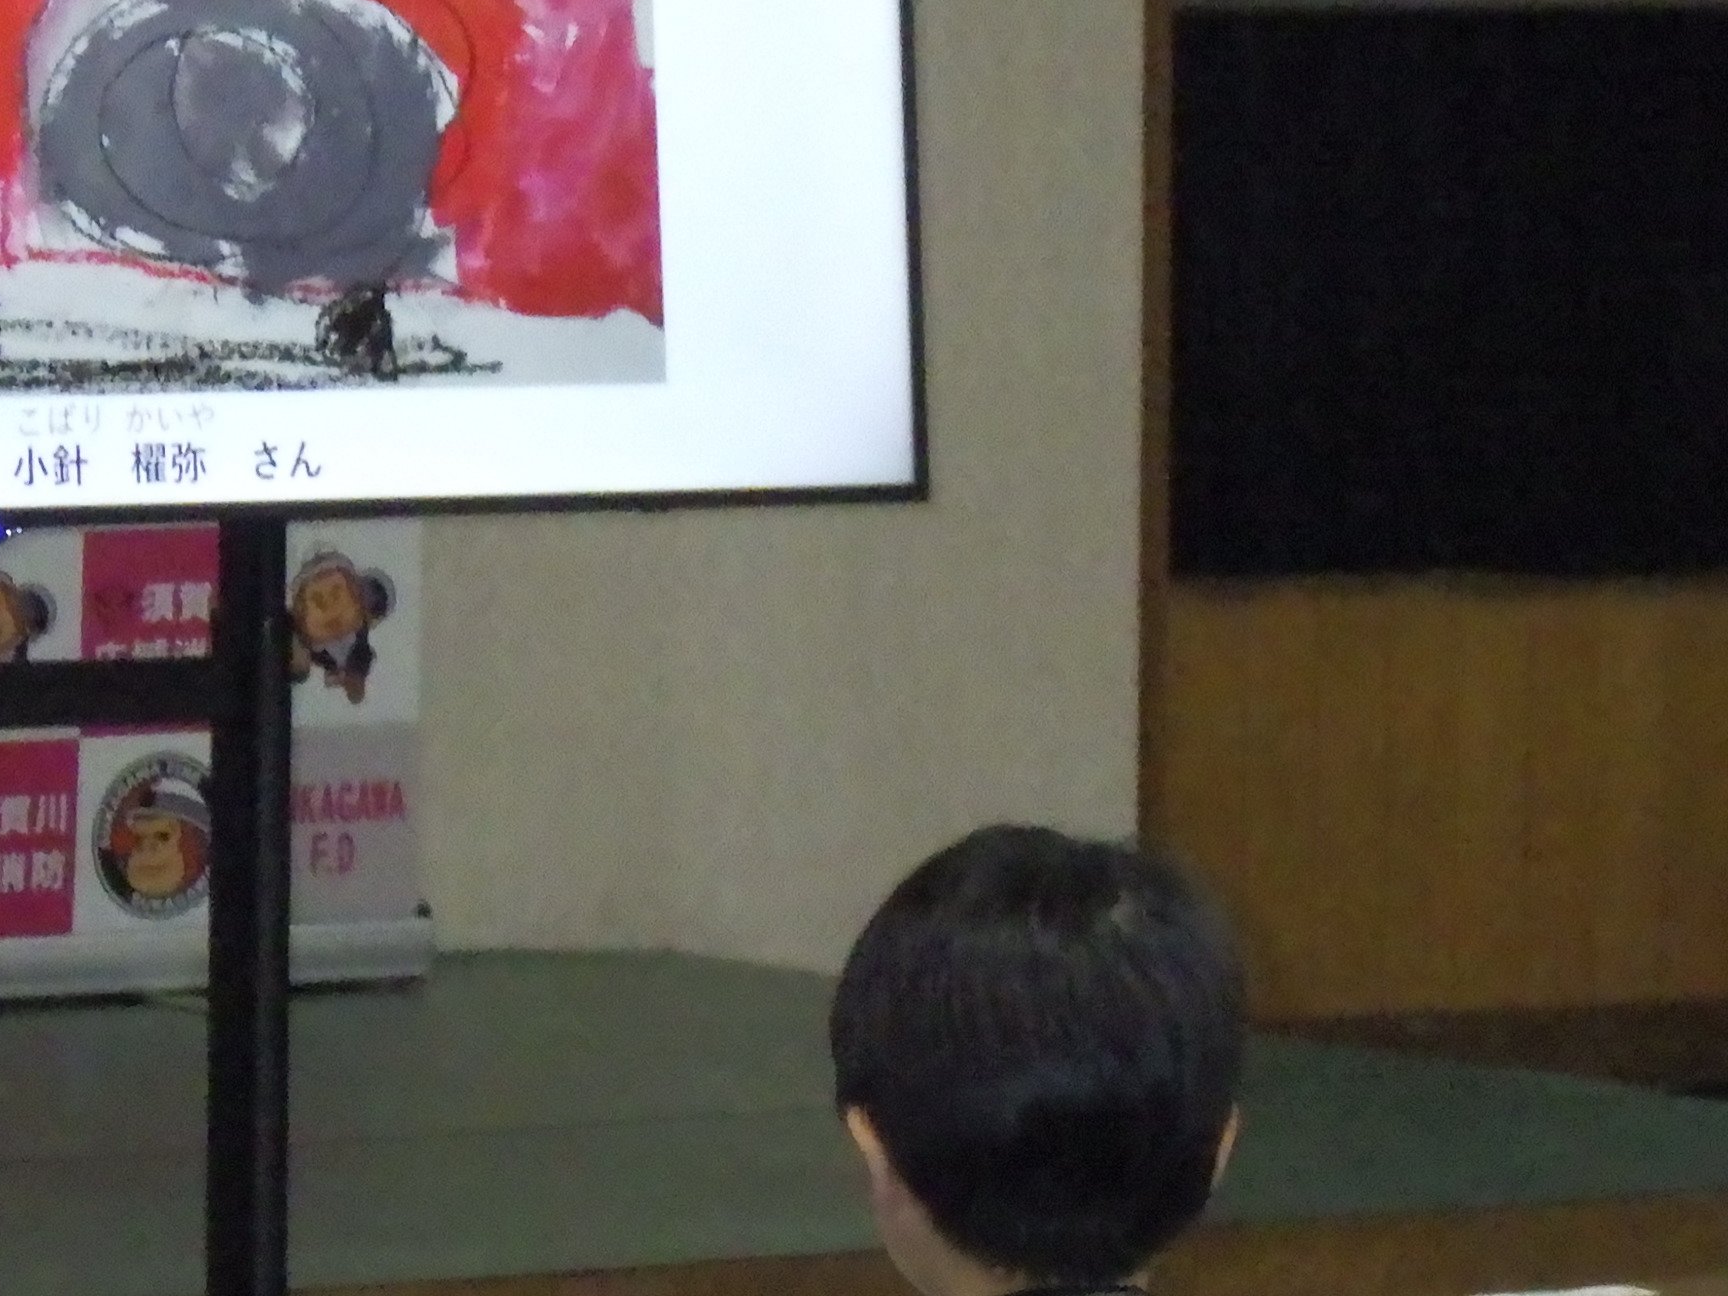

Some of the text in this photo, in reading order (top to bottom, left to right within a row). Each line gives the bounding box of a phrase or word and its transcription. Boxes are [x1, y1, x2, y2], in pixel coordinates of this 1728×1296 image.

[18, 402, 215, 437] こばり かいや
[14, 443, 88, 487] 小針
[254, 439, 322, 480] さん
[137, 583, 213, 622] 須賀
